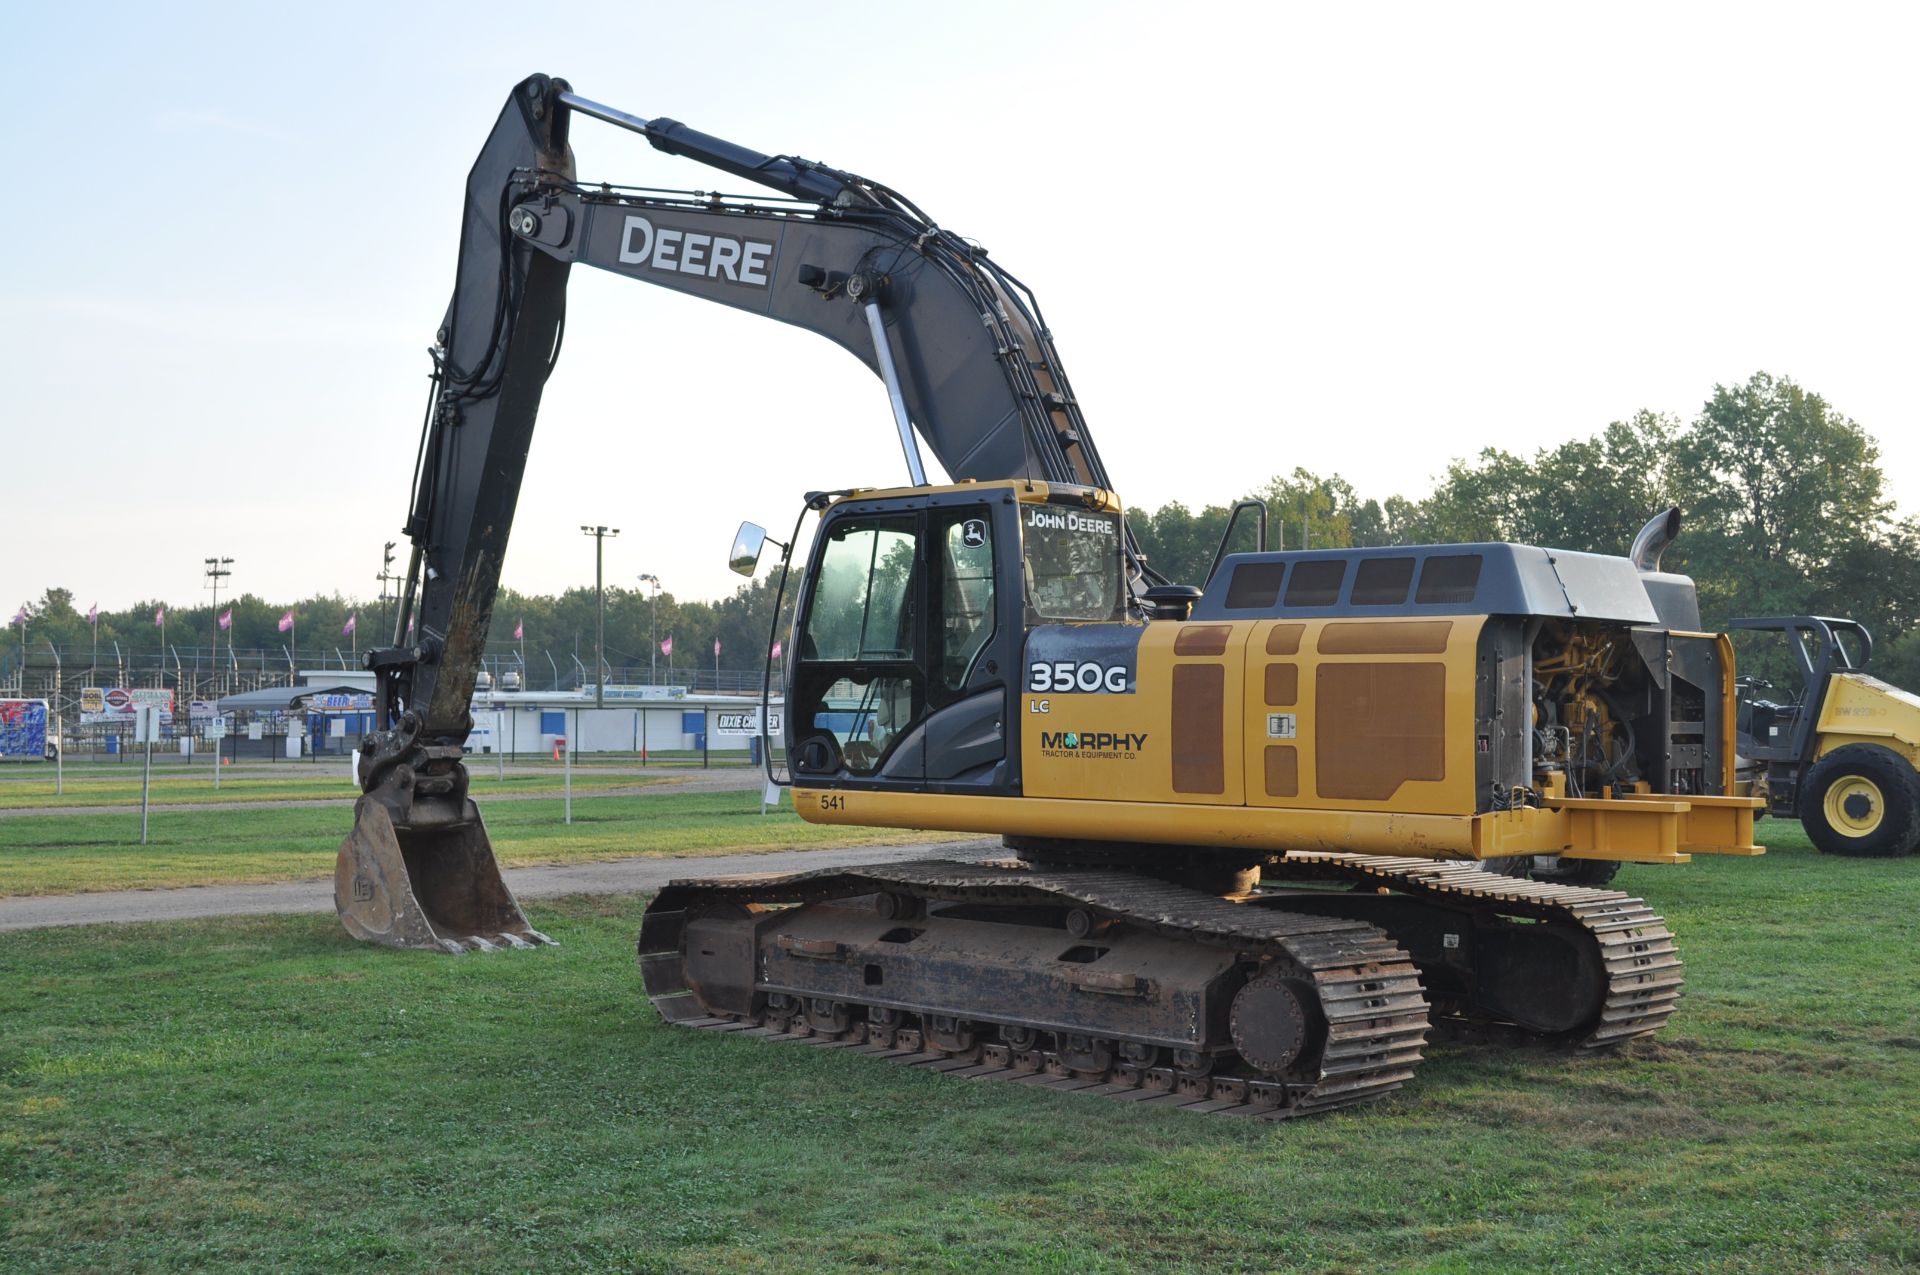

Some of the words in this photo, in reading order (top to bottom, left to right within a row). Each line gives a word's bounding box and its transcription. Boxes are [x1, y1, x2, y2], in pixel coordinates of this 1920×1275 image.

[619, 215, 772, 286] DEERE
[1027, 510, 1065, 529] JOHN
[1068, 514, 1113, 534] DEERE
[1030, 662, 1127, 692] 350G
[327, 696, 350, 707] BEER
[1031, 700, 1049, 713] LC
[719, 715, 742, 728] DIXIE
[1041, 750, 1074, 758] TRACTOR
[1081, 751, 1123, 759] EQUIPMENT
[1124, 752, 1136, 760] CO.
[821, 795, 844, 810] 541
